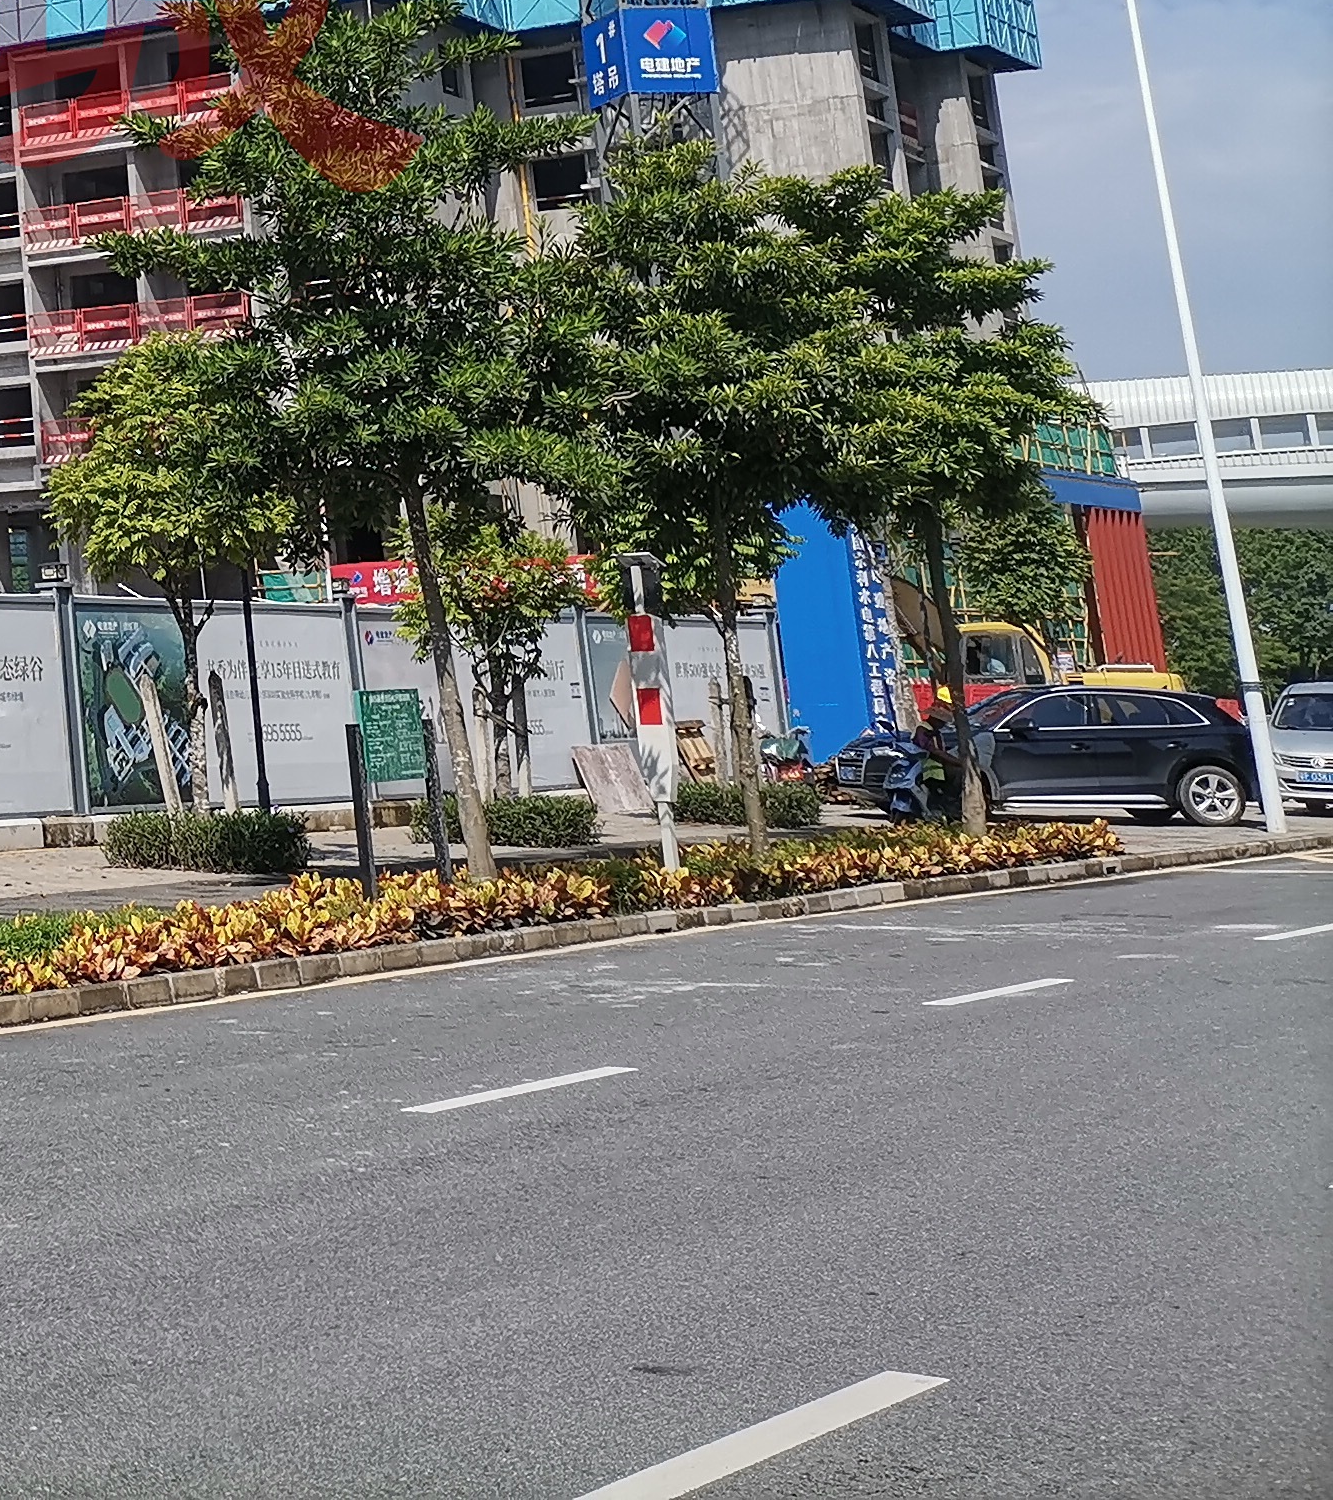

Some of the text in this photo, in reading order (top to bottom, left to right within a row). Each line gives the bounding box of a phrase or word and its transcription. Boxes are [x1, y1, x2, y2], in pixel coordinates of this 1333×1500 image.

[639, 57, 701, 73] 电建地产
[592, 65, 619, 96] 塔吊
